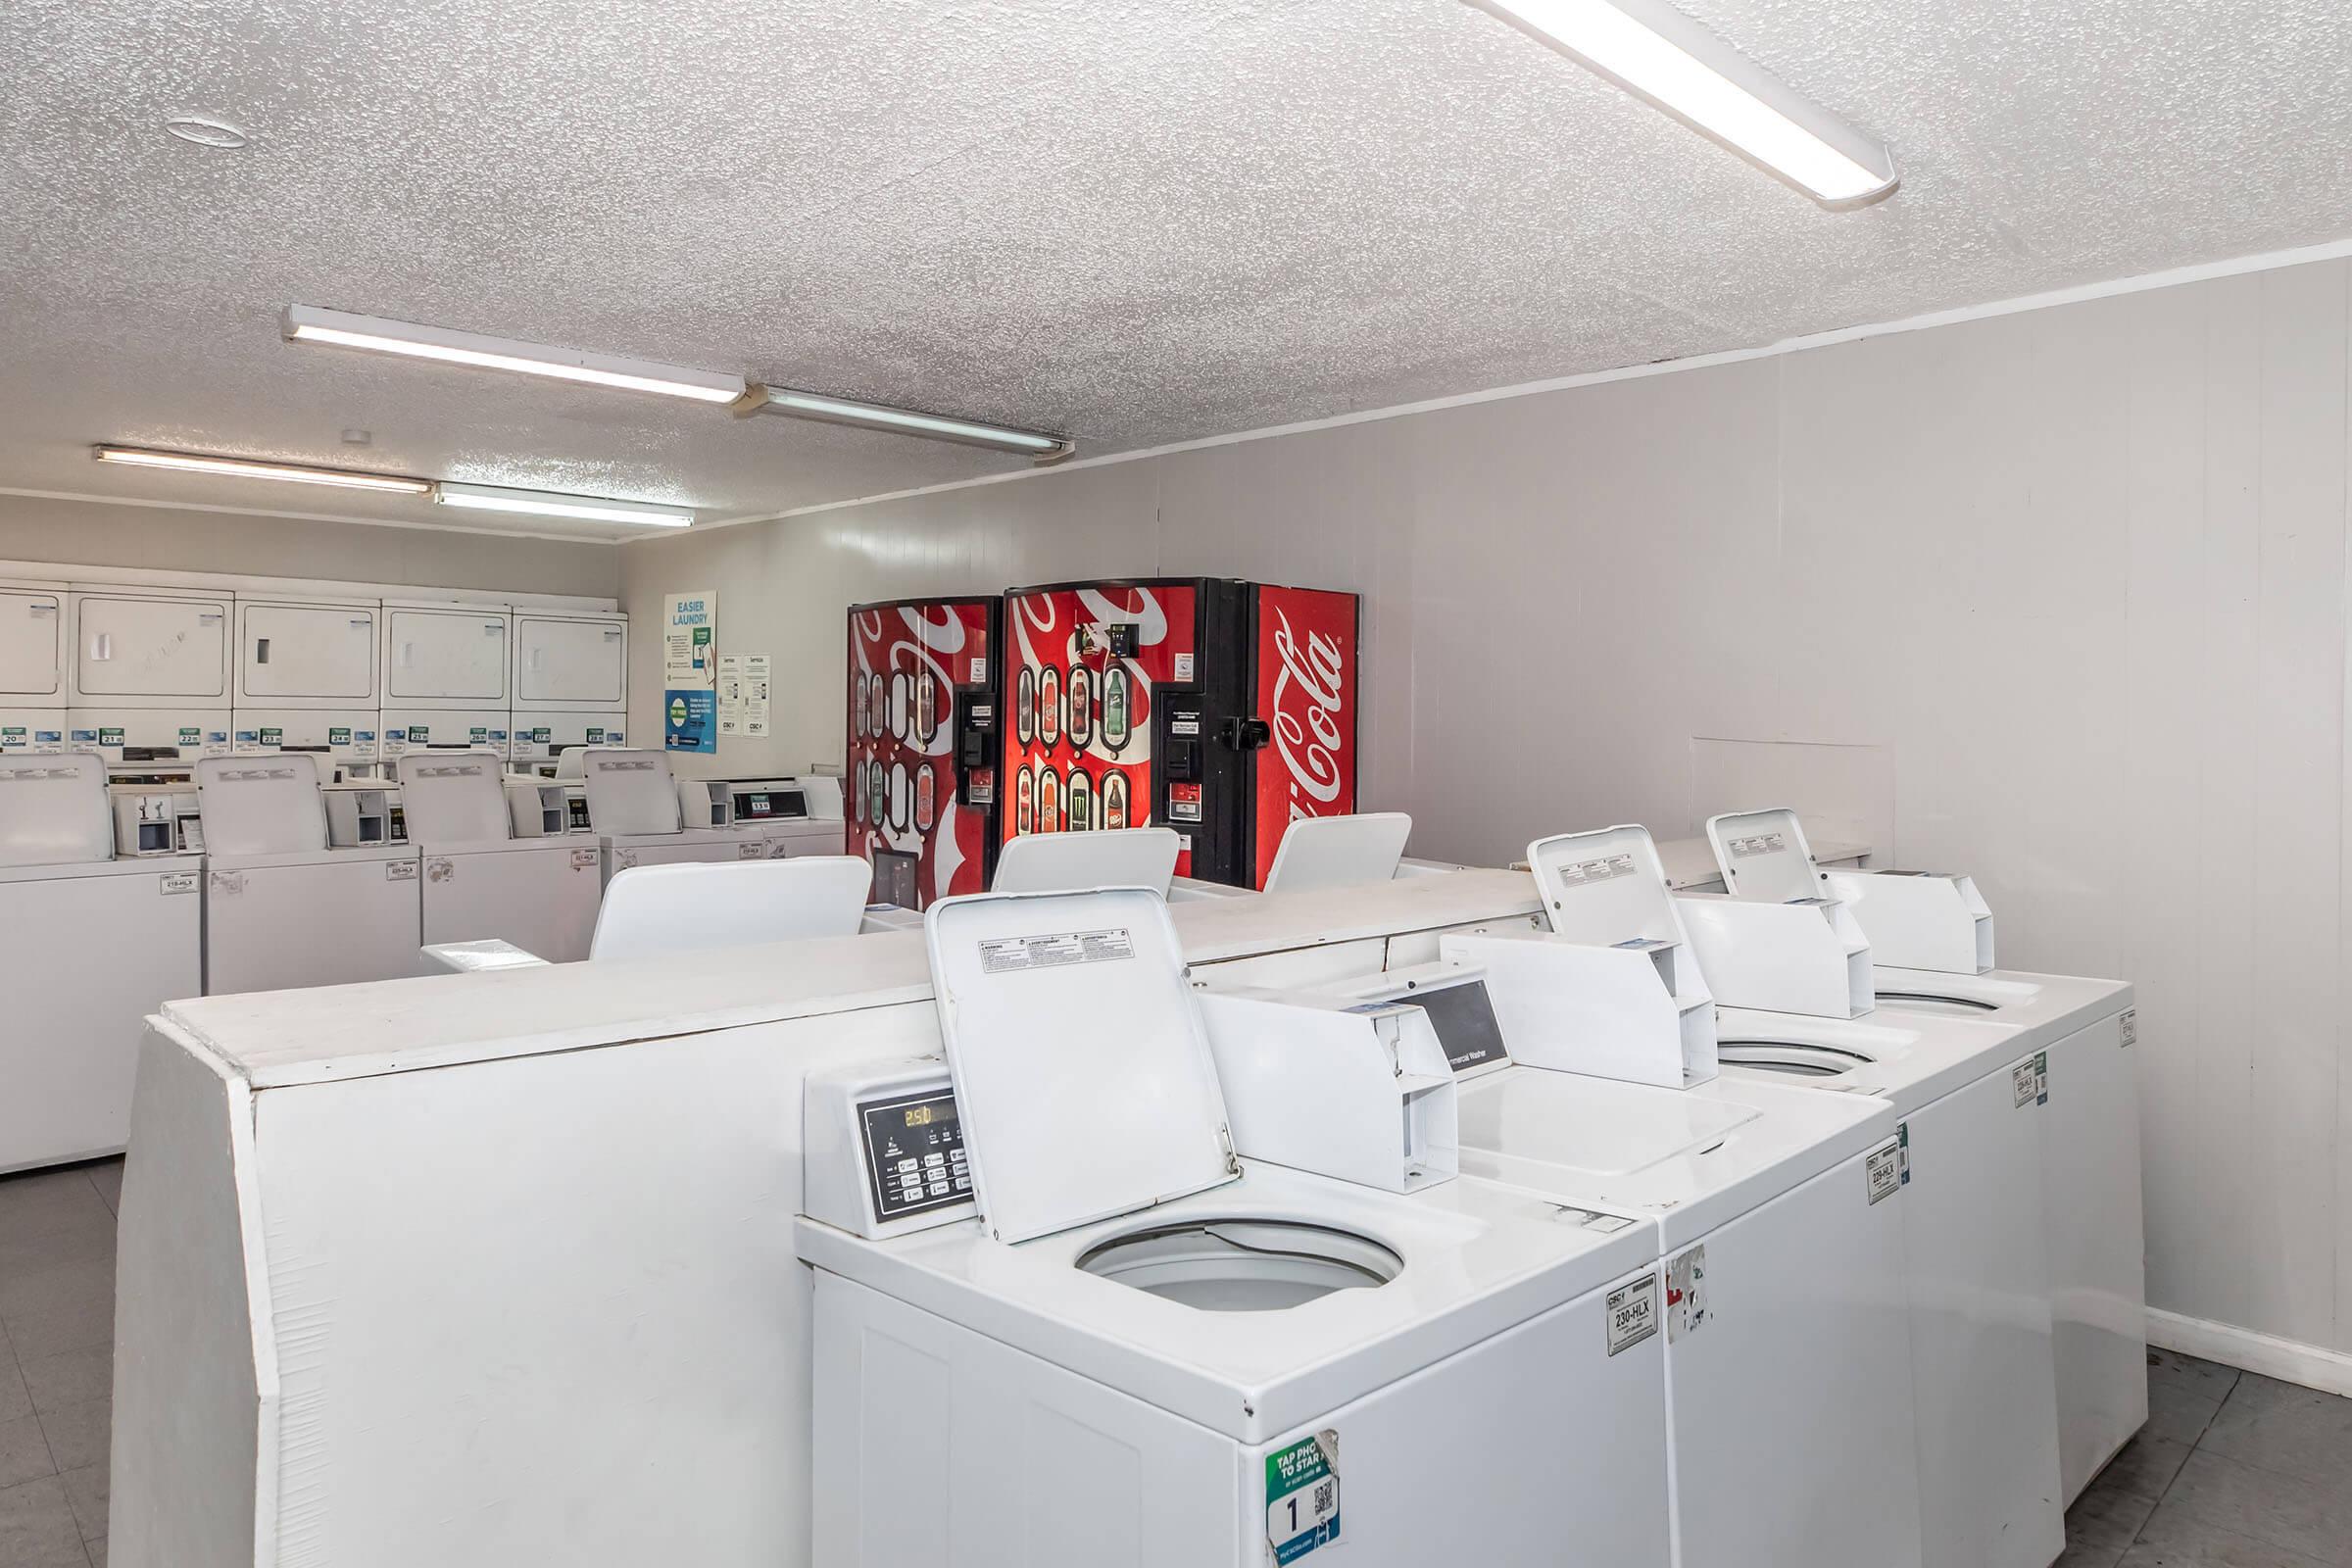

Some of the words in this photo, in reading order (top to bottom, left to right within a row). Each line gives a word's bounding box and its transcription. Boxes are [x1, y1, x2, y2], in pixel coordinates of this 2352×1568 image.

[677, 601, 705, 612] EASIER
[673, 613, 708, 625] LAUNDRY
[1608, 1293, 1622, 1306] CSC
[1615, 1299, 1650, 1329] 230-HLX
[1277, 1451, 1296, 1469] TAP
[1297, 1442, 1316, 1461] PHO
[1281, 1465, 1295, 1480] TO
[1287, 1496, 1297, 1533] 1
